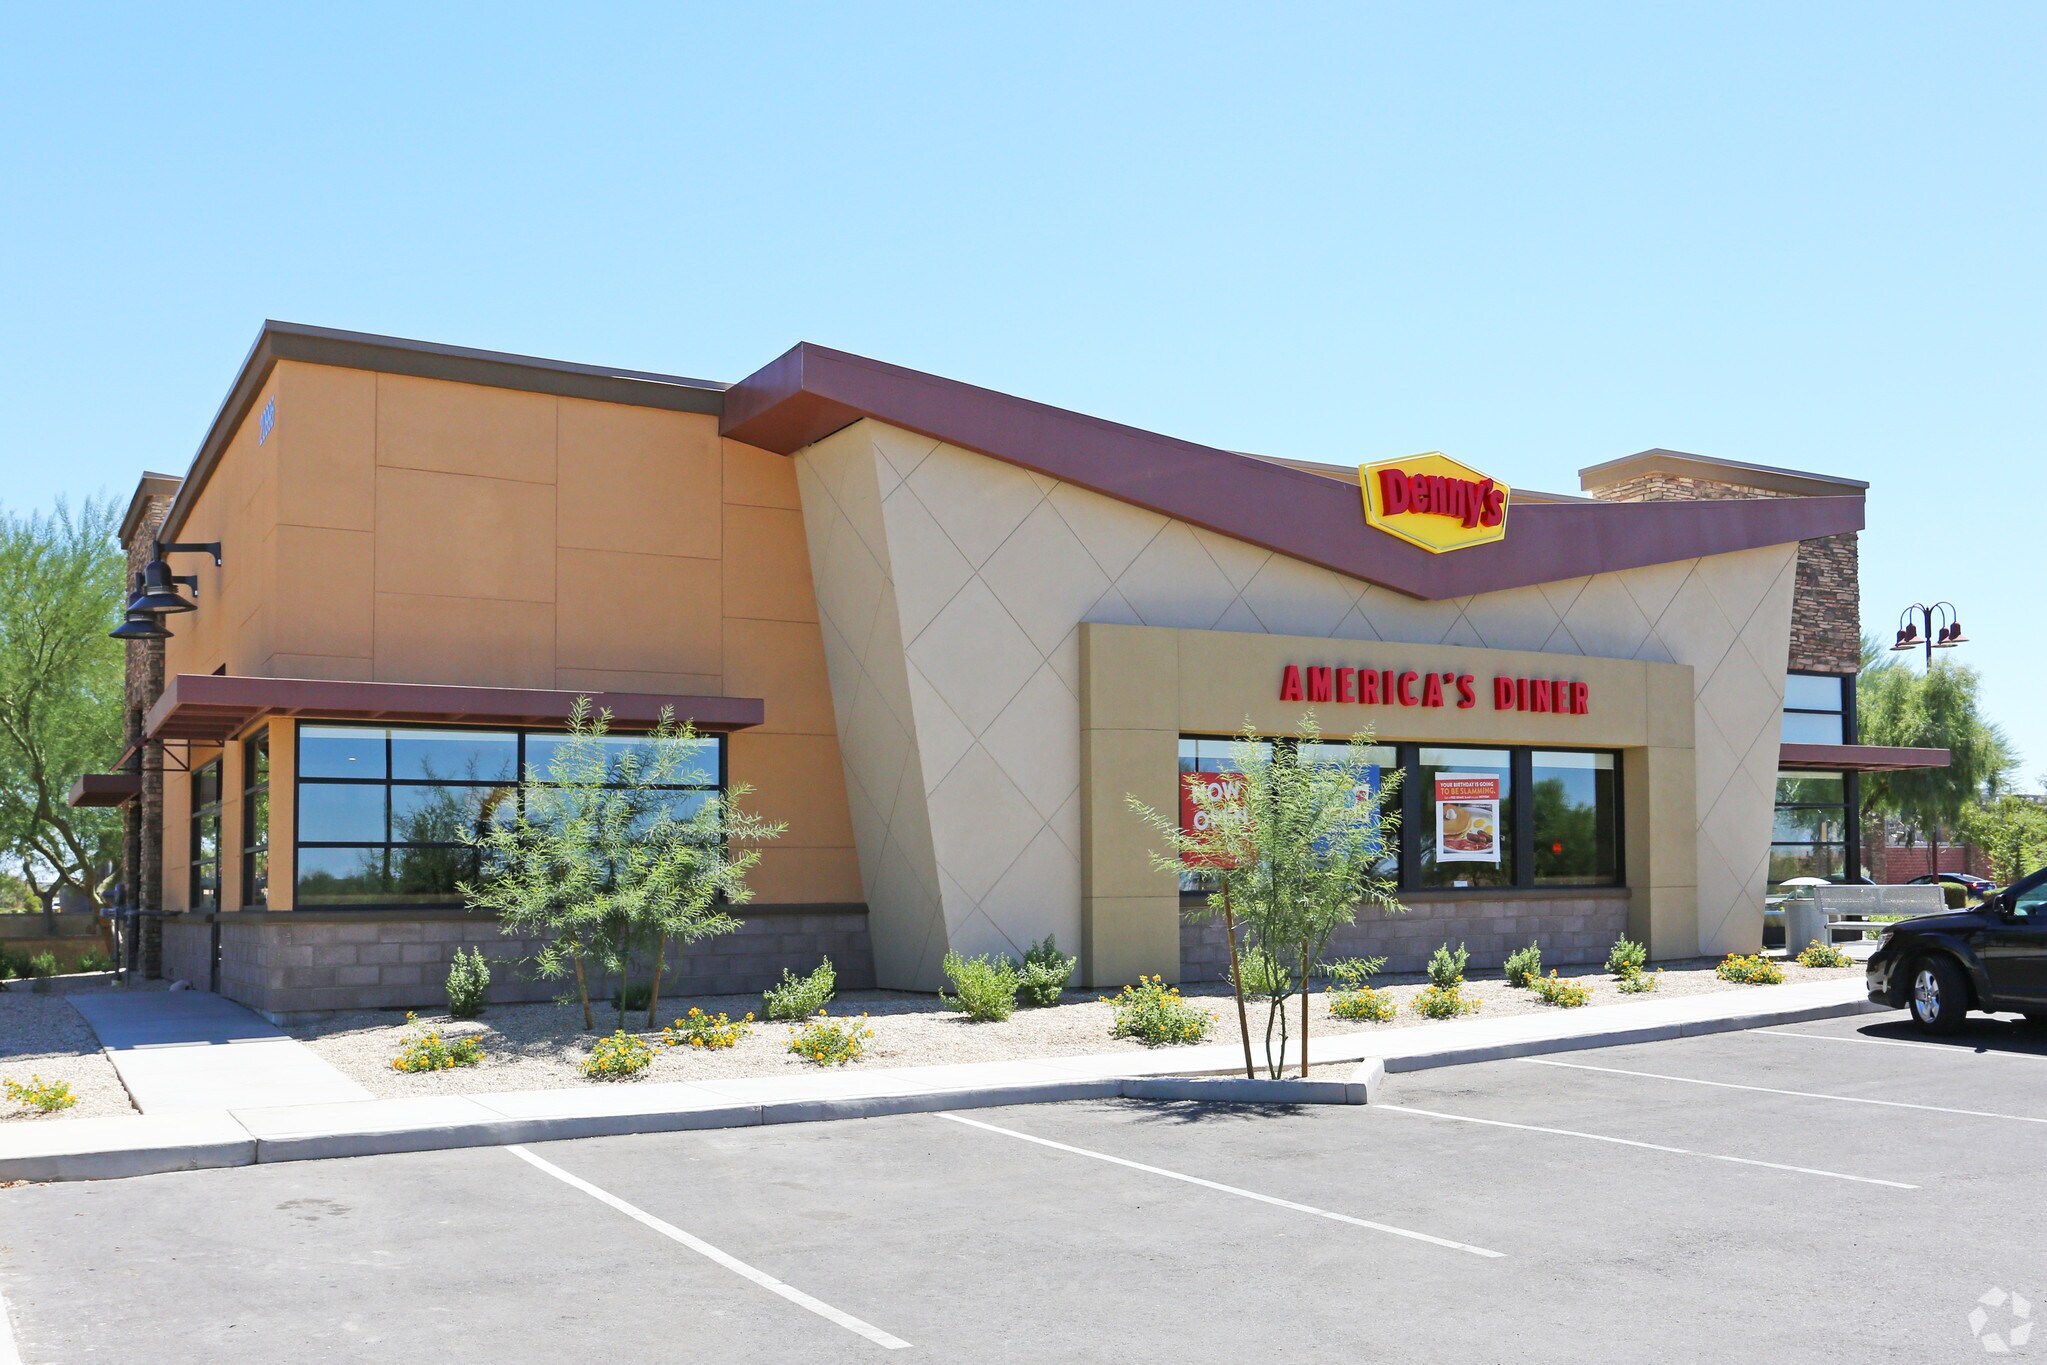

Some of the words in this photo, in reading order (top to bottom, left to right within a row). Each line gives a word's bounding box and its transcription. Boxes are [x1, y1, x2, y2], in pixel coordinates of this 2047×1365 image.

[1378, 469, 1504, 528] Denny's
[1280, 665, 1476, 708] AMERICA'S
[1494, 676, 1589, 714] DINER
[1440, 787, 1449, 795] TO
[1451, 787, 1459, 795] BE
[1460, 787, 1496, 795] SLAMMING.
